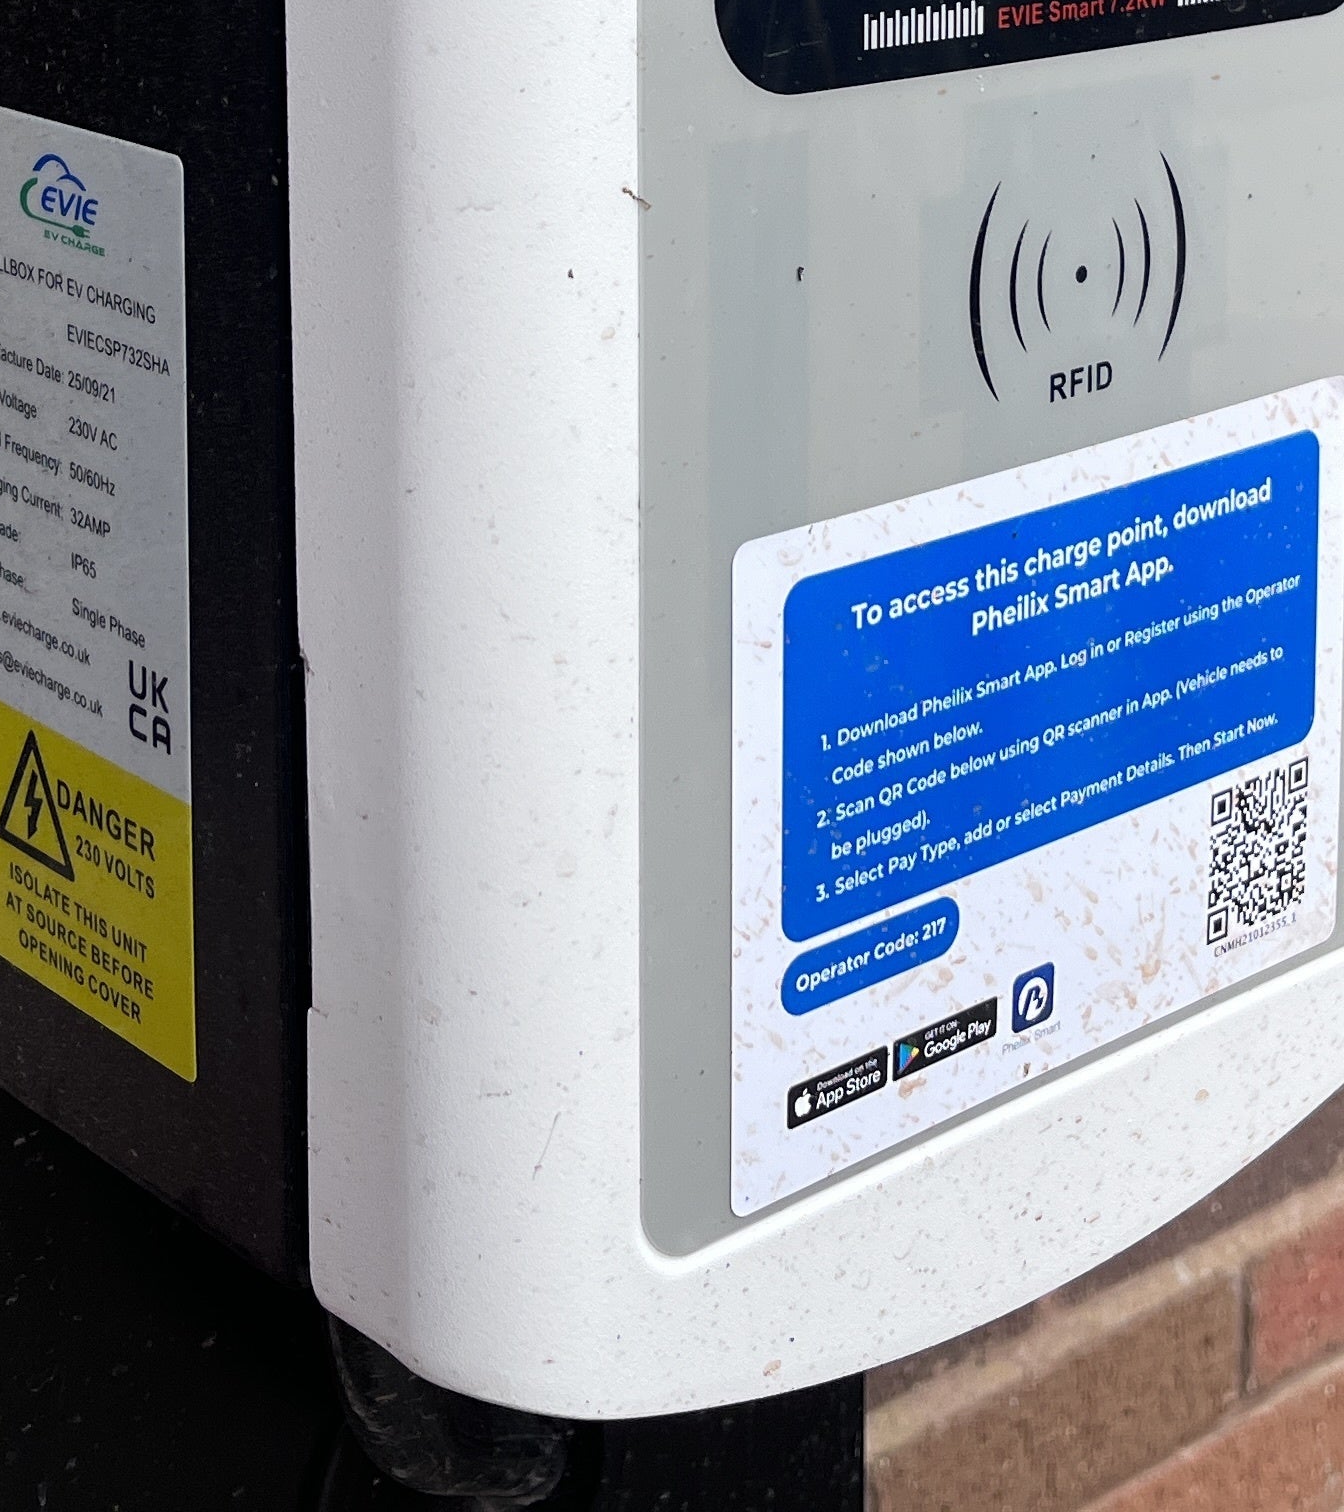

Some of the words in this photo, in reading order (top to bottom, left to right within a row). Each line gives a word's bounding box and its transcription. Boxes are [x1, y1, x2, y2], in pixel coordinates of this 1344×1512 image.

[997, 3, 1044, 30] EVIE
[41, 186, 99, 226] EVIE
[44, 229, 59, 241] EV
[61, 234, 106, 257] CHARGE
[38, 268, 64, 293] FOR
[67, 277, 84, 299] EV
[86, 285, 156, 324] CHARGING
[67, 323, 171, 377] EVIECSP732SHA
[36, 358, 65, 384] Date:
[68, 370, 116, 403] 25/09/21
[1049, 360, 1113, 404] RFID
[68, 416, 98, 442] 230V
[100, 429, 118, 451] AC
[70, 461, 116, 497] 50/60Hz
[21, 485, 64, 521] Current:
[70, 507, 111, 538] 32AMP
[71, 551, 97, 579] IP65
[851, 602, 883, 629] To
[888, 576, 969, 619] access
[975, 558, 1018, 591] this
[1024, 535, 1102, 576] charge
[1107, 514, 1169, 557] point,
[1172, 476, 1272, 530] download
[72, 597, 106, 629] Single
[109, 615, 146, 648] Phase
[971, 591, 1050, 636] Pheilix
[1054, 568, 1121, 609] Smart
[1124, 555, 1175, 587] App.
[128, 659, 170, 714] UK
[820, 734, 831, 752] 1.
[837, 703, 918, 746] Download
[921, 686, 973, 717] Pheilix
[976, 669, 1022, 698] Smart
[1023, 661, 1058, 684] App.
[1060, 647, 1087, 669] Log
[1090, 641, 1104, 659] in
[1106, 637, 1121, 653] or
[1124, 618, 1181, 648] Register
[1183, 602, 1218, 627] using
[1221, 593, 1244, 613] the
[1245, 573, 1301, 605] Operator
[128, 702, 172, 756] CA
[816, 809, 831, 829] 2.
[835, 795, 875, 822] Scan
[878, 783, 904, 808] QR
[906, 768, 947, 795] Code
[950, 751, 997, 780] below
[999, 735, 1040, 762] using
[1042, 724, 1065, 747] QR
[1067, 705, 1123, 737] scanner
[1126, 698, 1139, 716] in
[1141, 687, 1173, 710] App.
[1175, 663, 1229, 700] (Vehicle
[1230, 651, 1269, 677] needs
[1270, 645, 1284, 660] to
[831, 759, 874, 786] Code
[877, 740, 930, 771] shown
[933, 721, 983, 750] below.
[56, 778, 156, 862] DANGER
[815, 883, 830, 903] 3.
[834, 863, 885, 896] Select
[887, 851, 918, 875] Pay
[920, 837, 961, 863] Type,
[963, 819, 993, 844] add
[996, 816, 1012, 832] or
[1014, 796, 1057, 826] select
[1060, 772, 1124, 809] Payment
[1126, 751, 1176, 782] Details.
[1178, 738, 1211, 762] Then
[1212, 722, 1245, 748] Start
[1246, 712, 1279, 733] Now.
[831, 839, 852, 861] be
[856, 809, 931, 855] plugged).
[75, 834, 101, 867] 230
[104, 849, 155, 900] VOLTS
[9, 861, 71, 916] ISOLATE
[74, 900, 108, 937] THIS
[111, 928, 148, 964] UNIT
[6, 891, 22, 914] AT
[26, 904, 87, 960] SOURCE
[91, 941, 154, 1001] BEFORE
[795, 950, 871, 993] Operator
[874, 929, 919, 960] Code:
[922, 917, 947, 942] 217
[18, 928, 85, 987] OPENING
[88, 974, 142, 1025] COVER
[924, 1027, 939, 1041] GET
[924, 1028, 967, 1058] Google
[967, 1019, 992, 1040] Play
[816, 1067, 854, 1091] Download
[816, 1086, 845, 1110] App
[846, 1070, 882, 1095] Store
